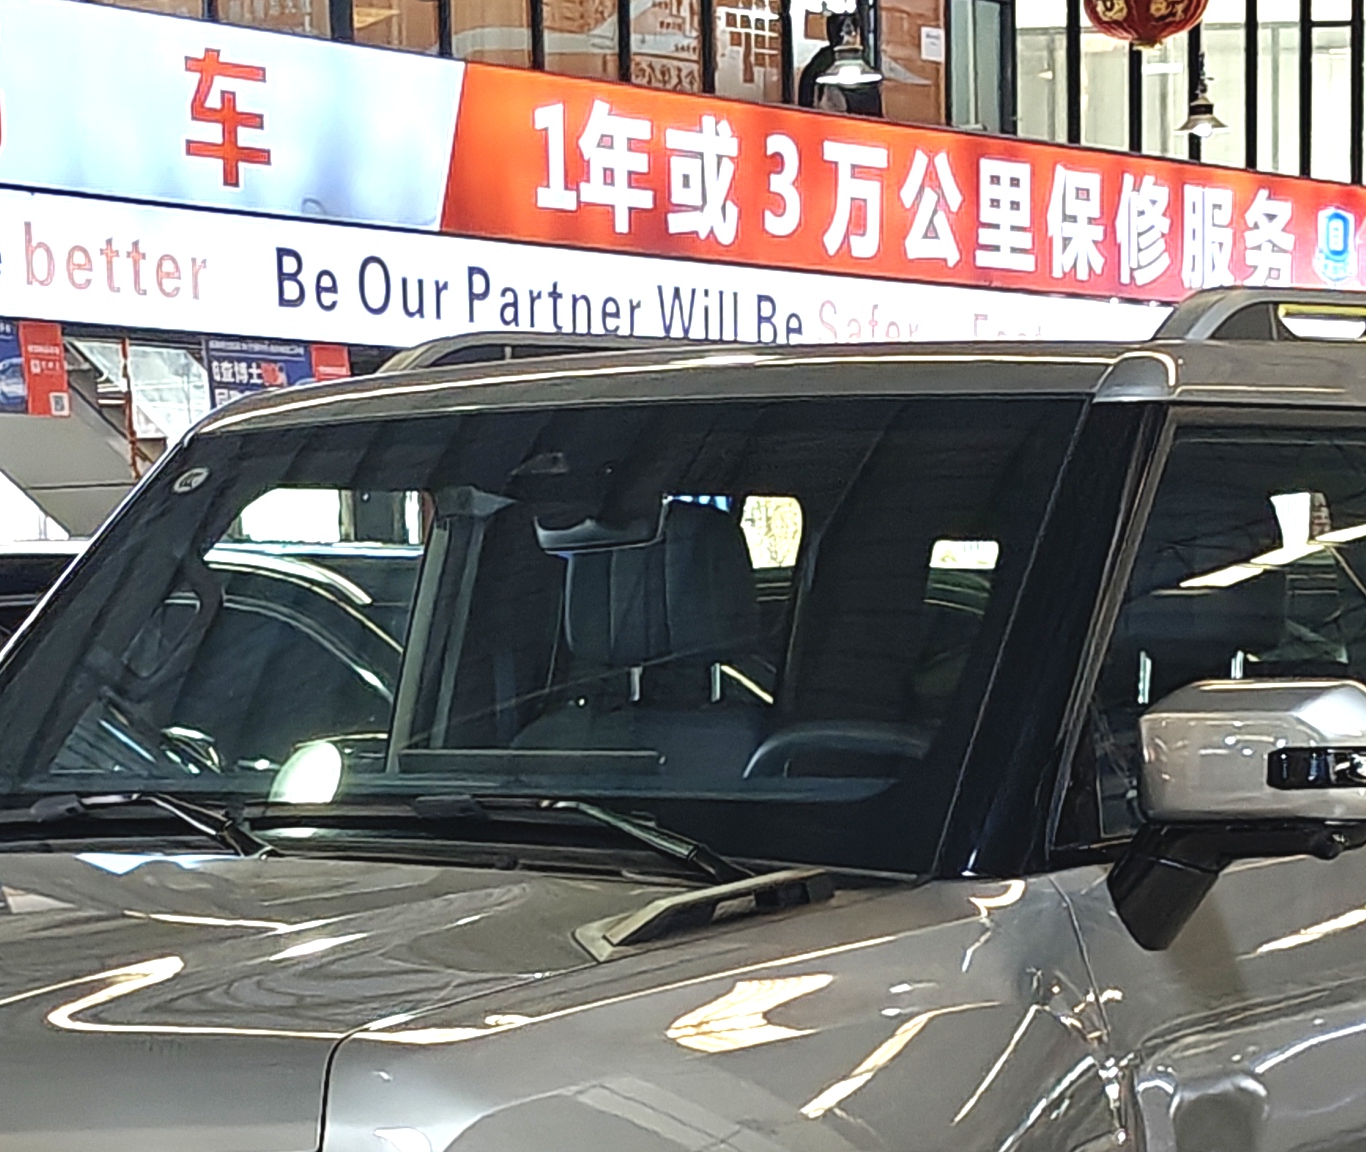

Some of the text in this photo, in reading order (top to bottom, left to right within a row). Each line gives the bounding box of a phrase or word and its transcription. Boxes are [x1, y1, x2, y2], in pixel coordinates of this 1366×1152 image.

[24, 221, 206, 300] better
[276, 246, 338, 311] Be
[358, 255, 448, 320] Our
[467, 266, 641, 336] Partner
[657, 284, 738, 340] Will
[756, 295, 803, 343] Be
